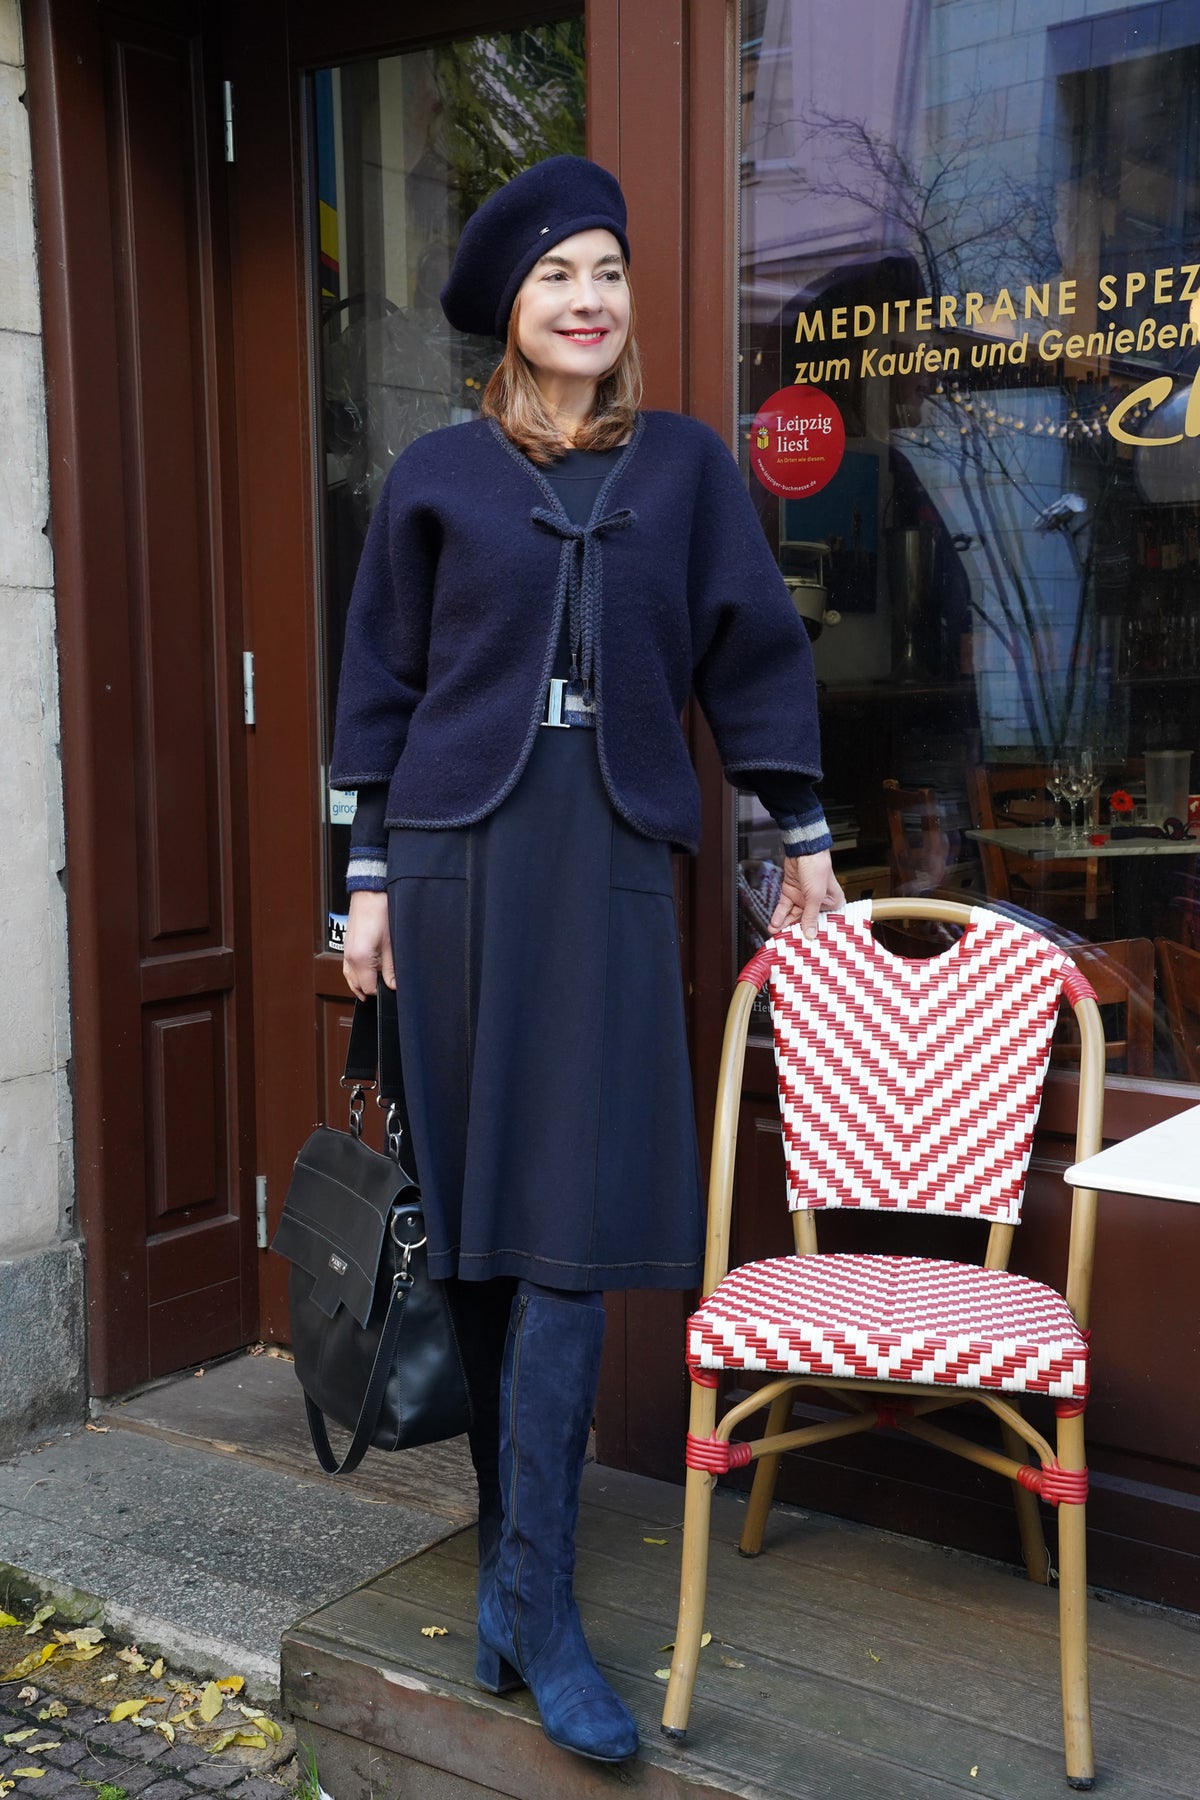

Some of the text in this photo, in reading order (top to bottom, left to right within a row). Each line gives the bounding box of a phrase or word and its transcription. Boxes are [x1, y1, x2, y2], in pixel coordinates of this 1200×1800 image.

[795, 264, 1200, 343] MEDITERRANE SPEZ
[794, 318, 1198, 384] zum Kaufen und Genießen
[776, 413, 832, 435] Leipzig
[777, 436, 809, 453] liest
[757, 458, 817, 491] www.leipziger-buchmesse.de
